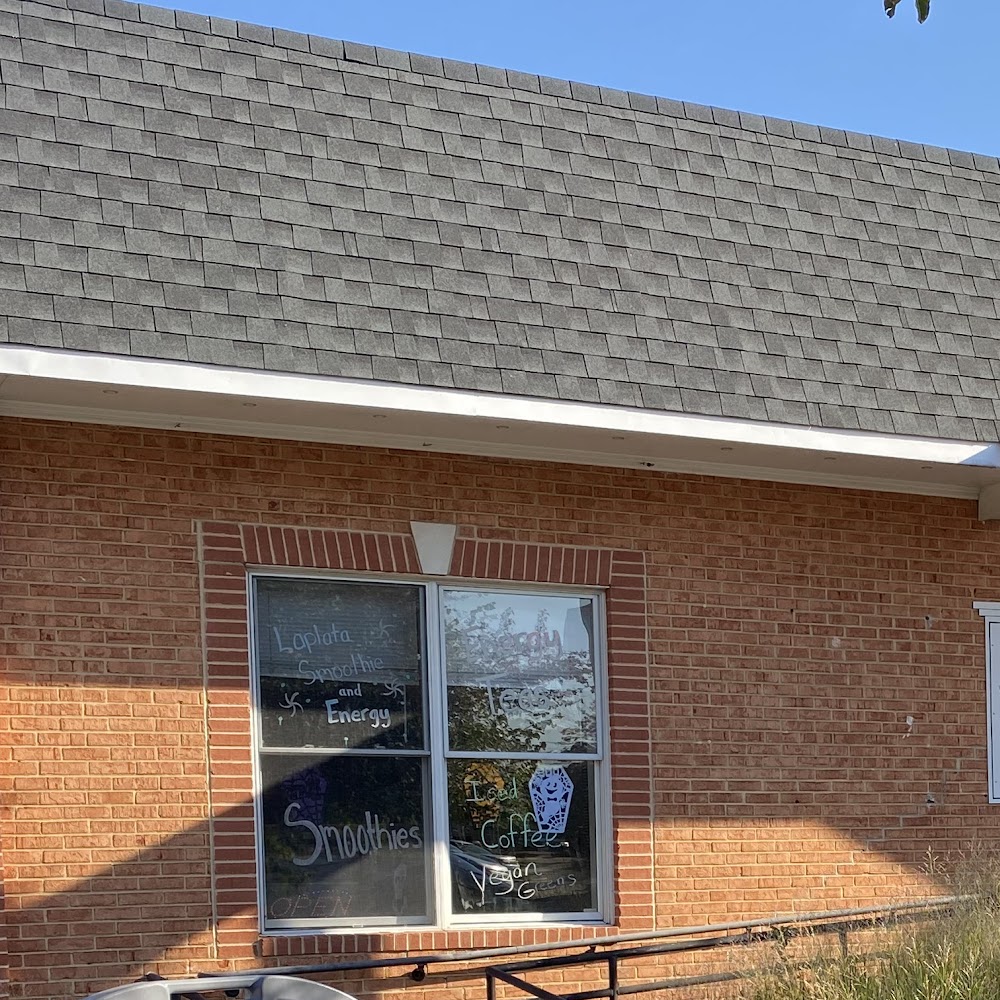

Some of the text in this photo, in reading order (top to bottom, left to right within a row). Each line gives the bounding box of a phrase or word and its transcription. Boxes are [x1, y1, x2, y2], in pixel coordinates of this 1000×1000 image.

[273, 623, 353, 654] Laplata
[339, 683, 363, 697] and
[325, 699, 392, 728] Energy
[284, 802, 423, 866] Smoothies
[481, 812, 562, 849] Coffee
